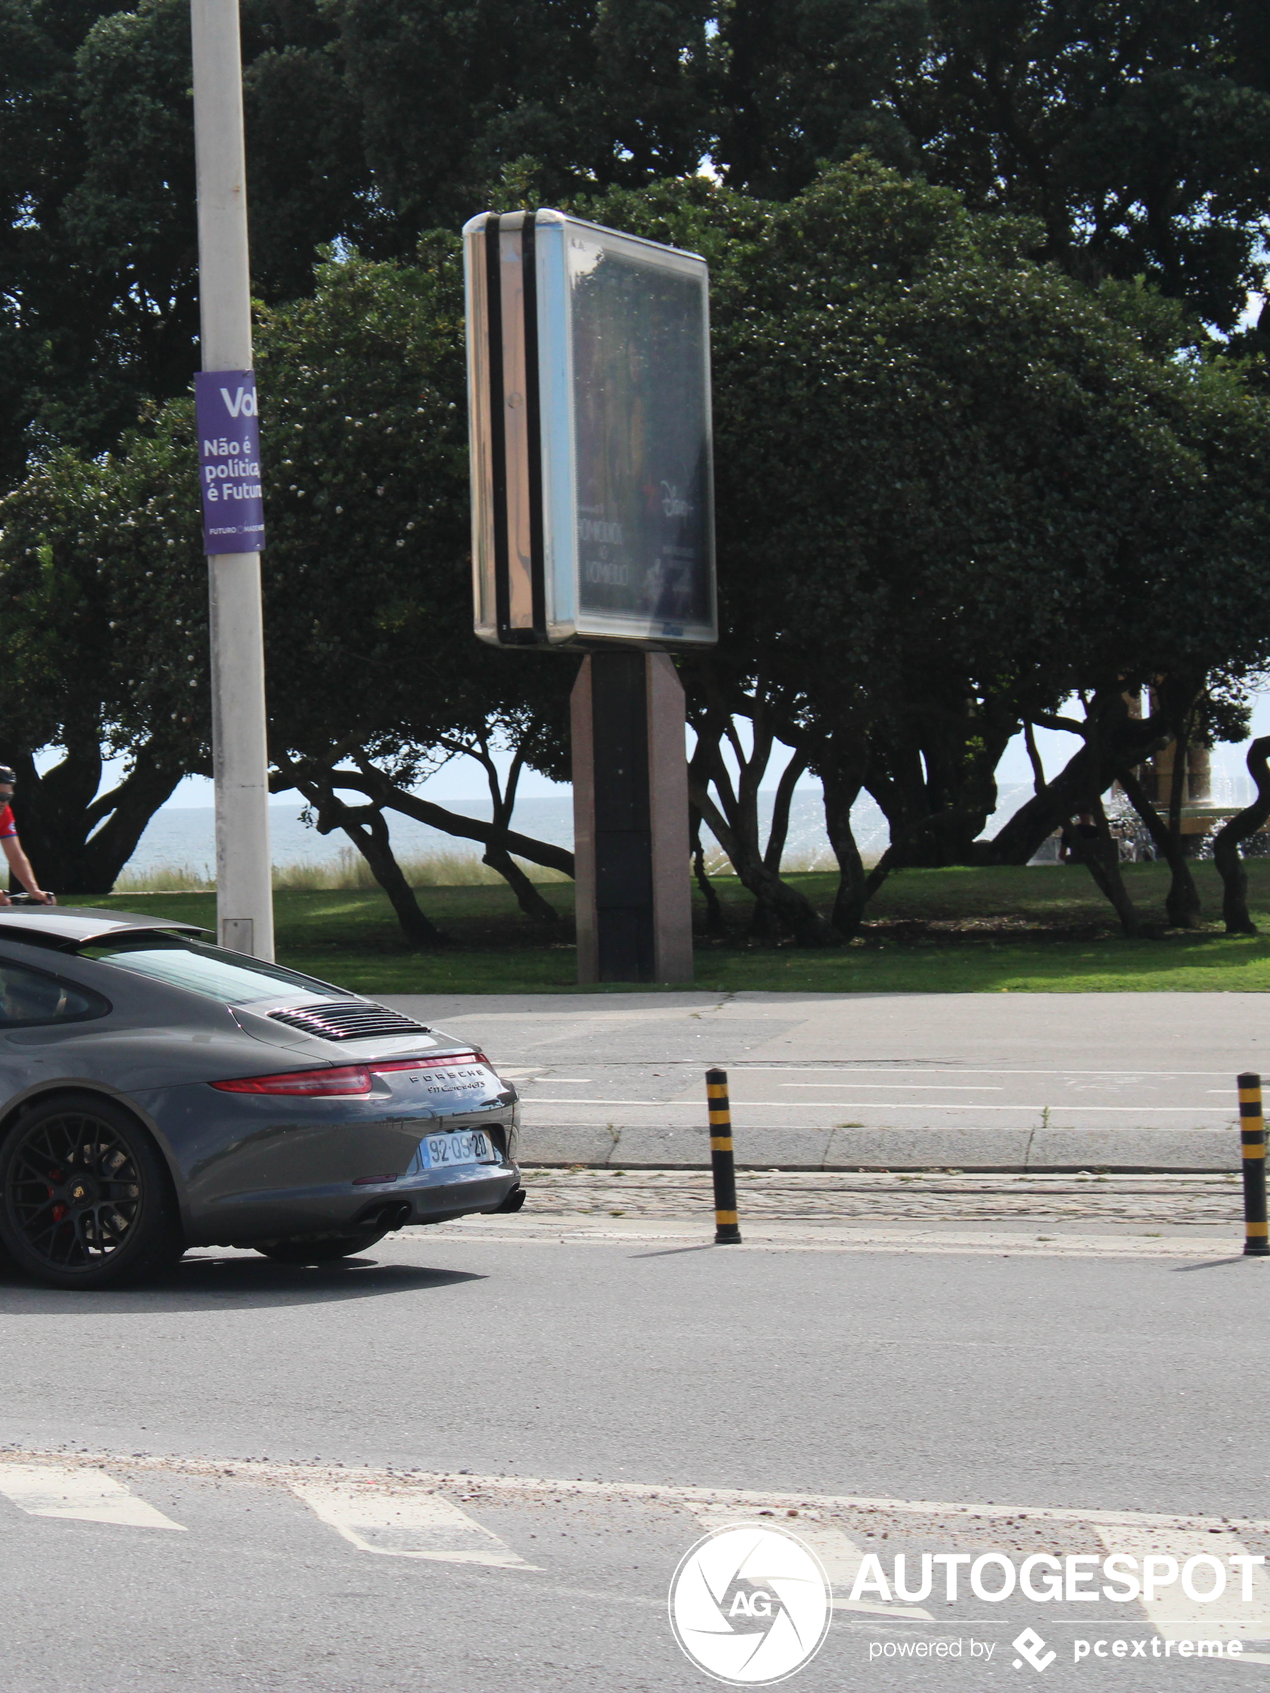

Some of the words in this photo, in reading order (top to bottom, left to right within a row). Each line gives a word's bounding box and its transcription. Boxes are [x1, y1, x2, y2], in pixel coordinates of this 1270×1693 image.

[204, 437, 240, 457] Não
[243, 436, 251, 454] é
[207, 483, 219, 501] é
[209, 526, 237, 535] FUTURO
[409, 1069, 485, 1084] PORSCHE
